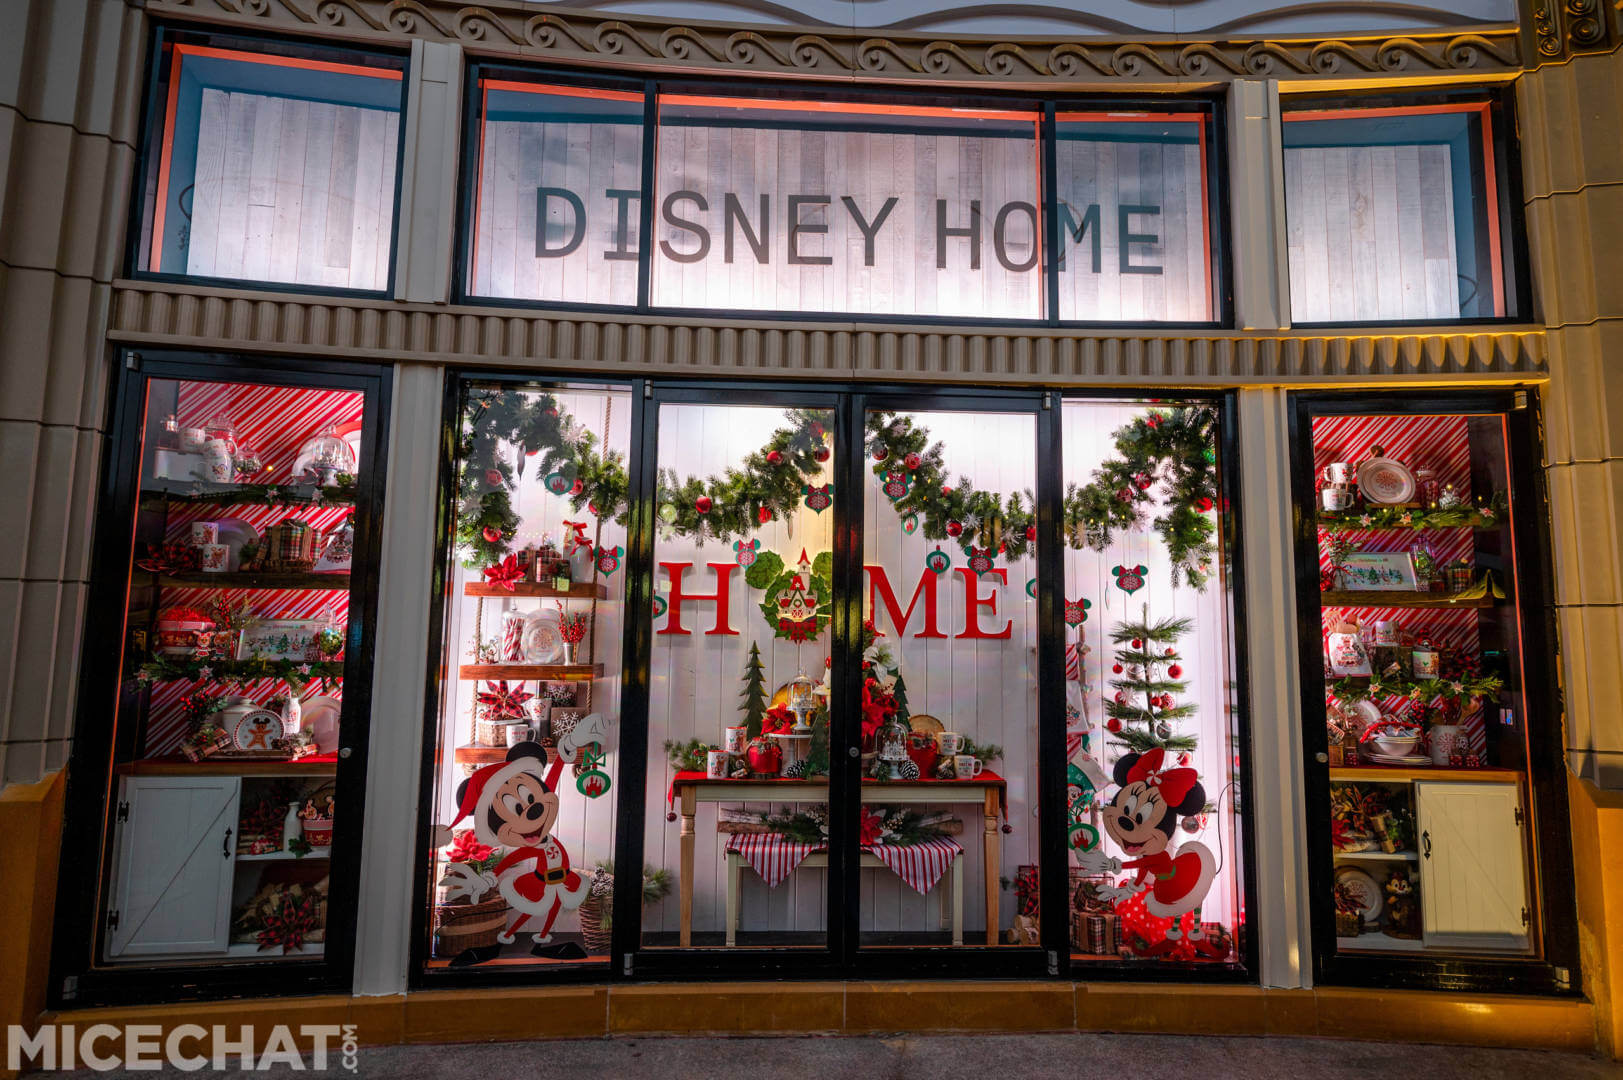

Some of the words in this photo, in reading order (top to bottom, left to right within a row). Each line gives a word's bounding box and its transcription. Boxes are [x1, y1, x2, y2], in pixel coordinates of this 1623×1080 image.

[535, 186, 899, 267] DISNEY
[936, 198, 1163, 275] HOME
[656, 561, 1013, 640] HME
